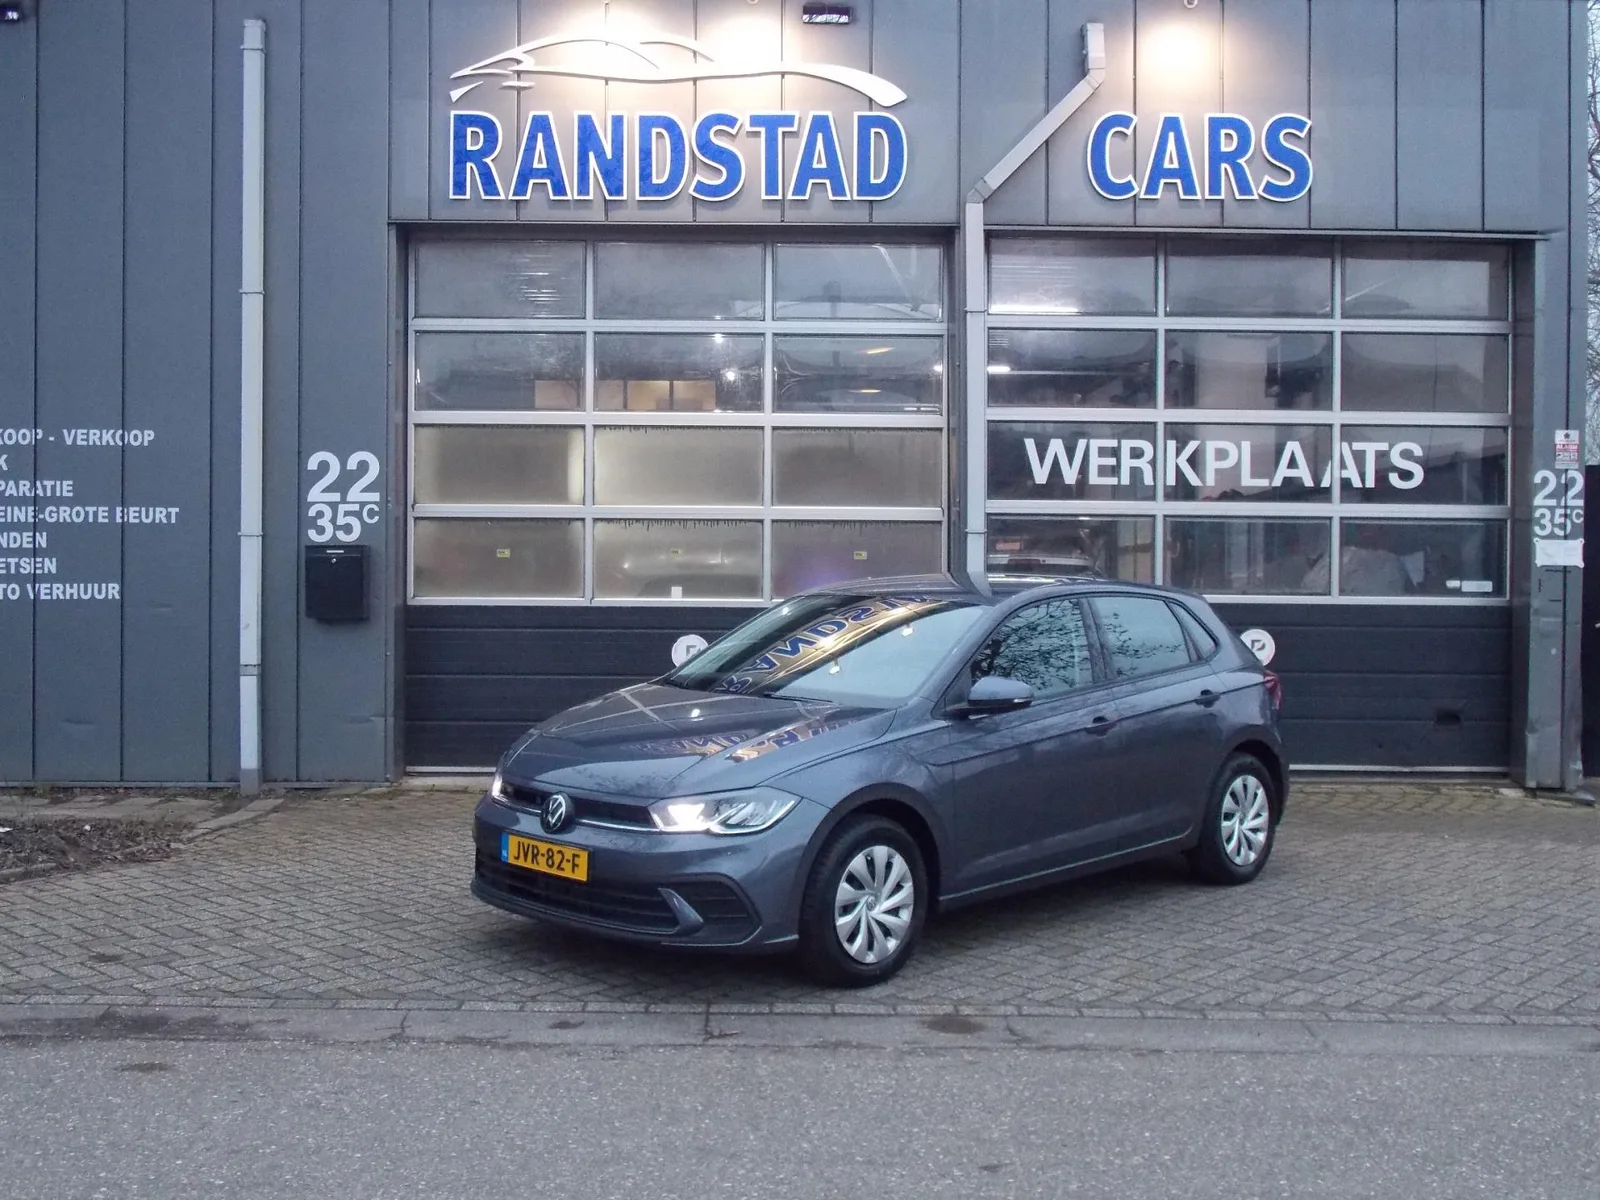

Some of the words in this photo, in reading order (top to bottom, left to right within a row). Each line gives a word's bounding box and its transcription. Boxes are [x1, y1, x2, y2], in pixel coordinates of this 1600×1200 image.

[448, 109, 909, 202] RANDSTAD
[1085, 111, 1314, 203] CARS
[63, 429, 155, 447] VERKOOP
[307, 451, 380, 502] 22
[1024, 438, 1425, 490] WERKPLAATS
[1533, 470, 1584, 506] 22
[115, 507, 179, 523] BEURT
[26, 583, 120, 600] VERHUUR
[513, 840, 580, 875] JVR-82-F
